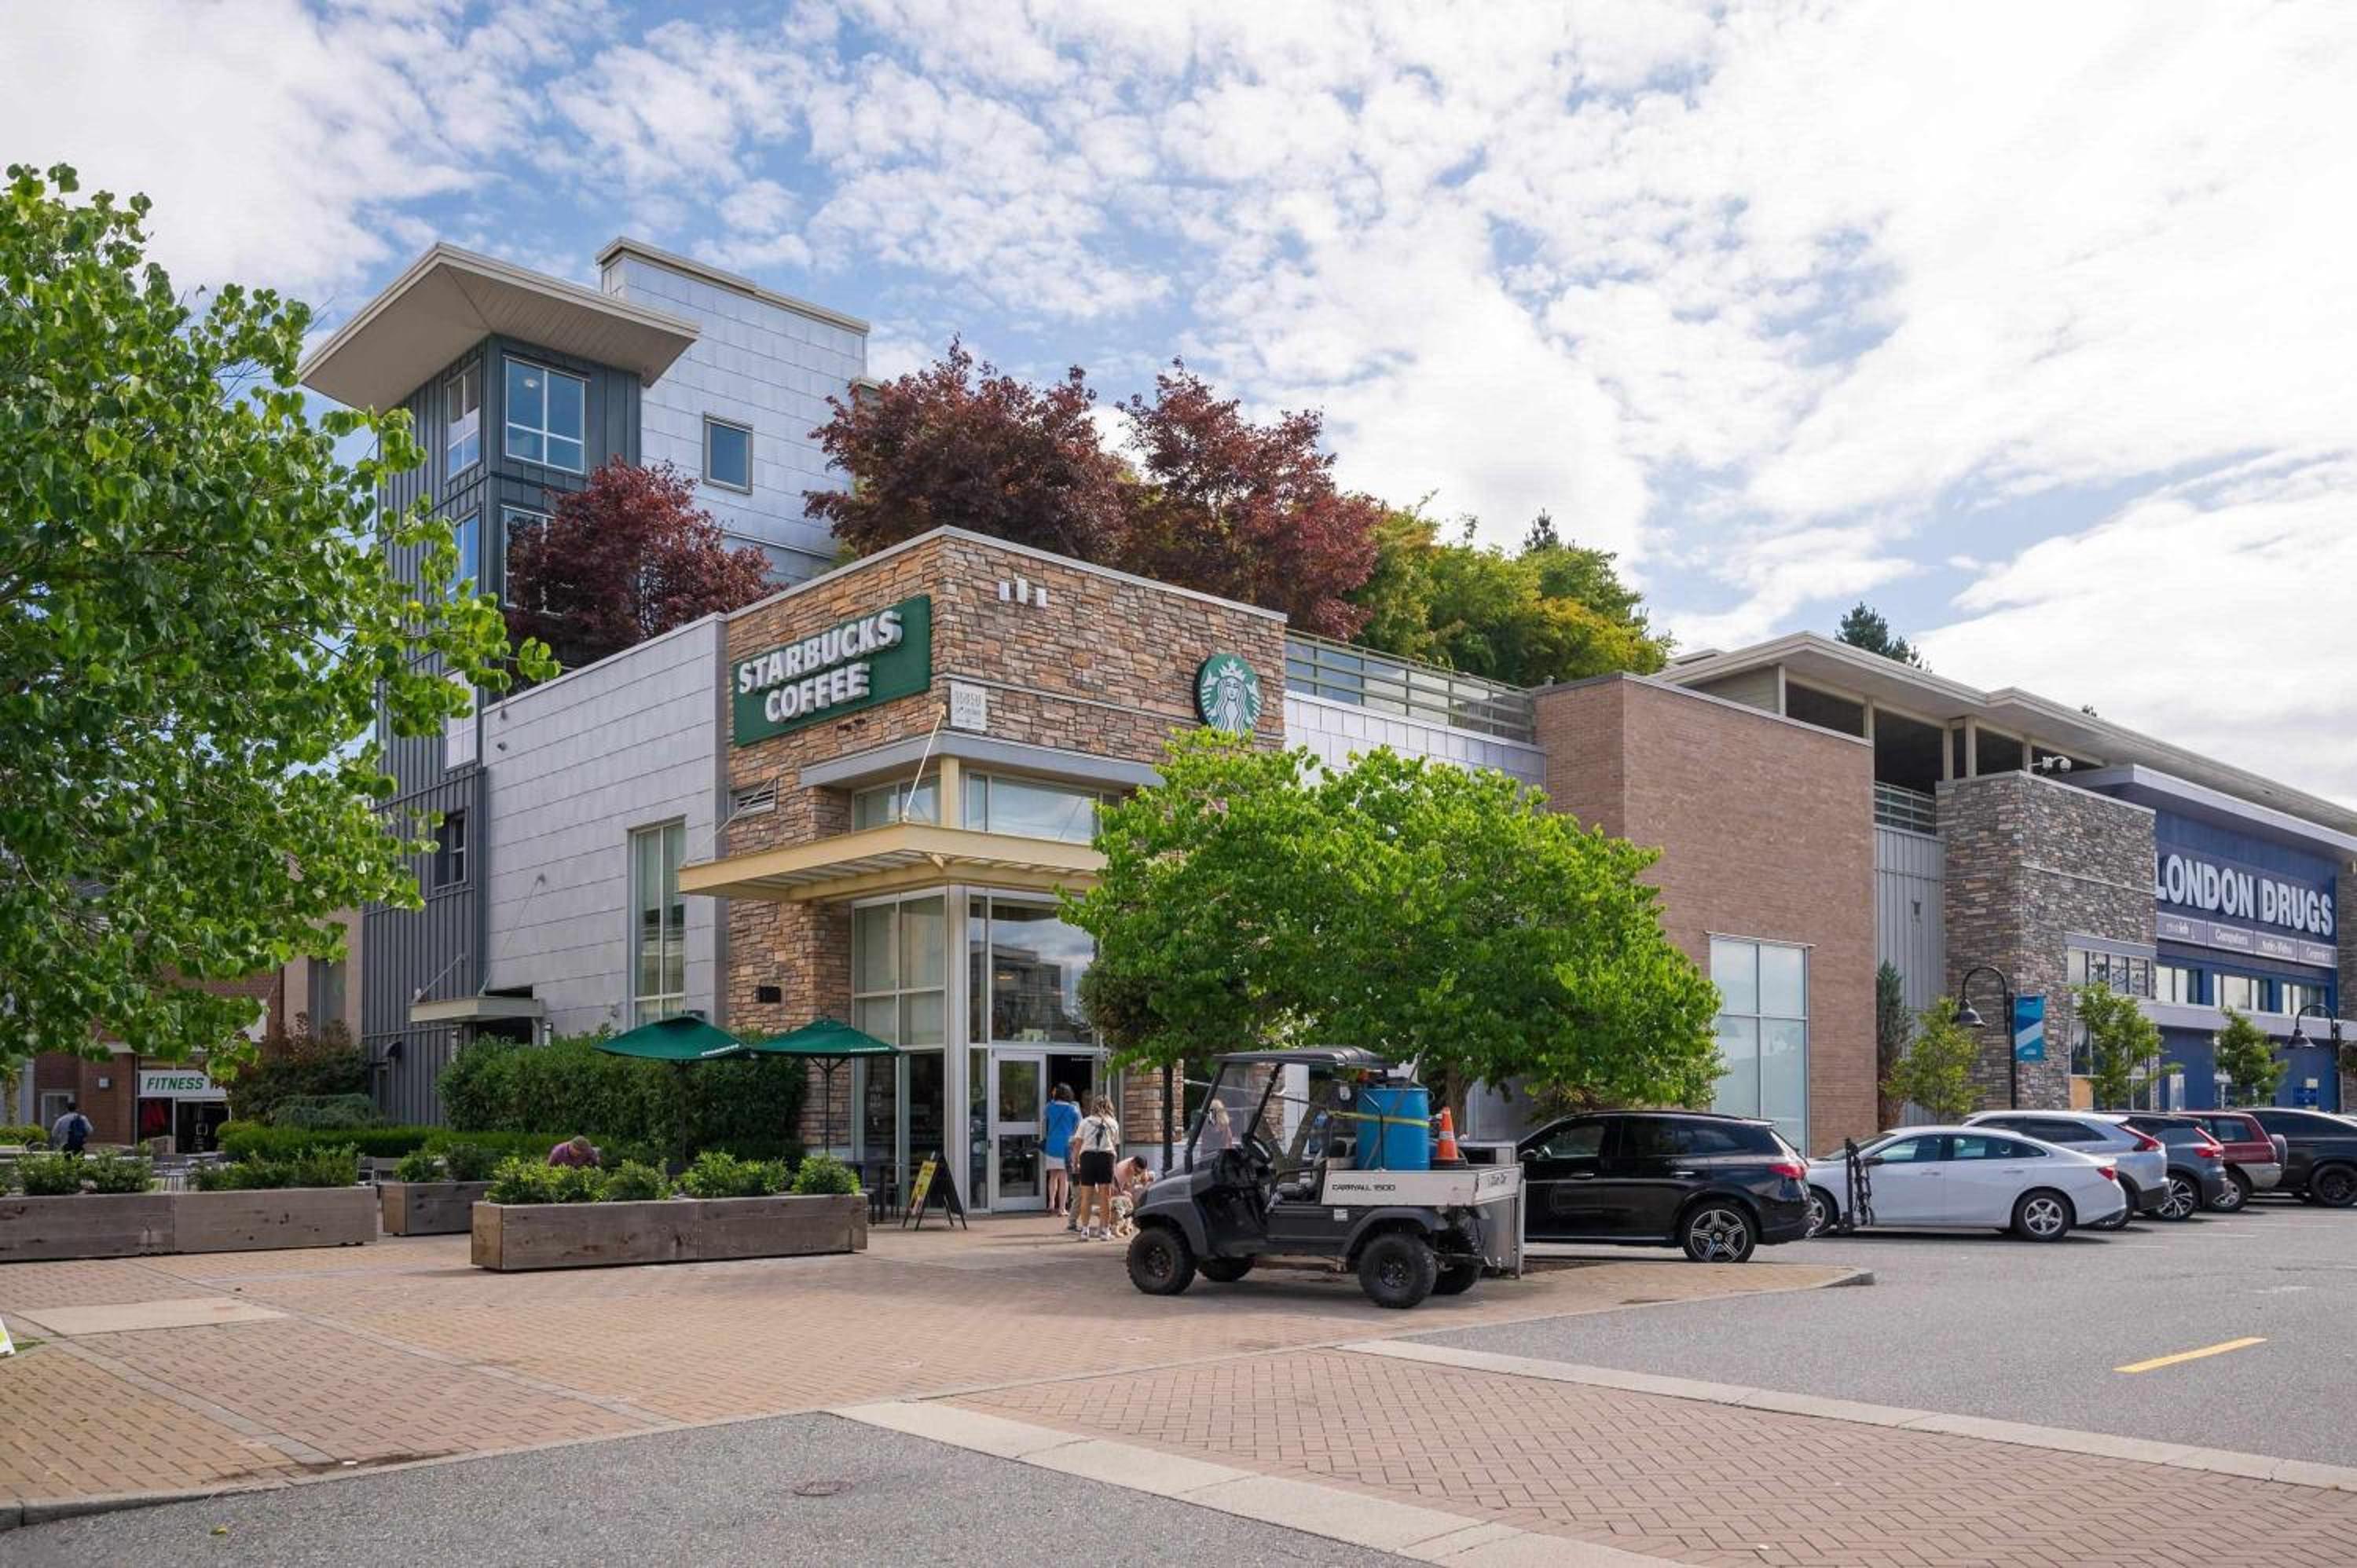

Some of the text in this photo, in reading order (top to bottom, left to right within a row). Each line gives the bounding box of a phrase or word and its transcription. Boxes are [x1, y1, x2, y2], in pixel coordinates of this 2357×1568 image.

[739, 611, 902, 694] STARBUCKS
[765, 662, 870, 722] COFFEE
[2154, 852, 2333, 936] LONDON DRUGS
[146, 1077, 204, 1090] FITNESS
